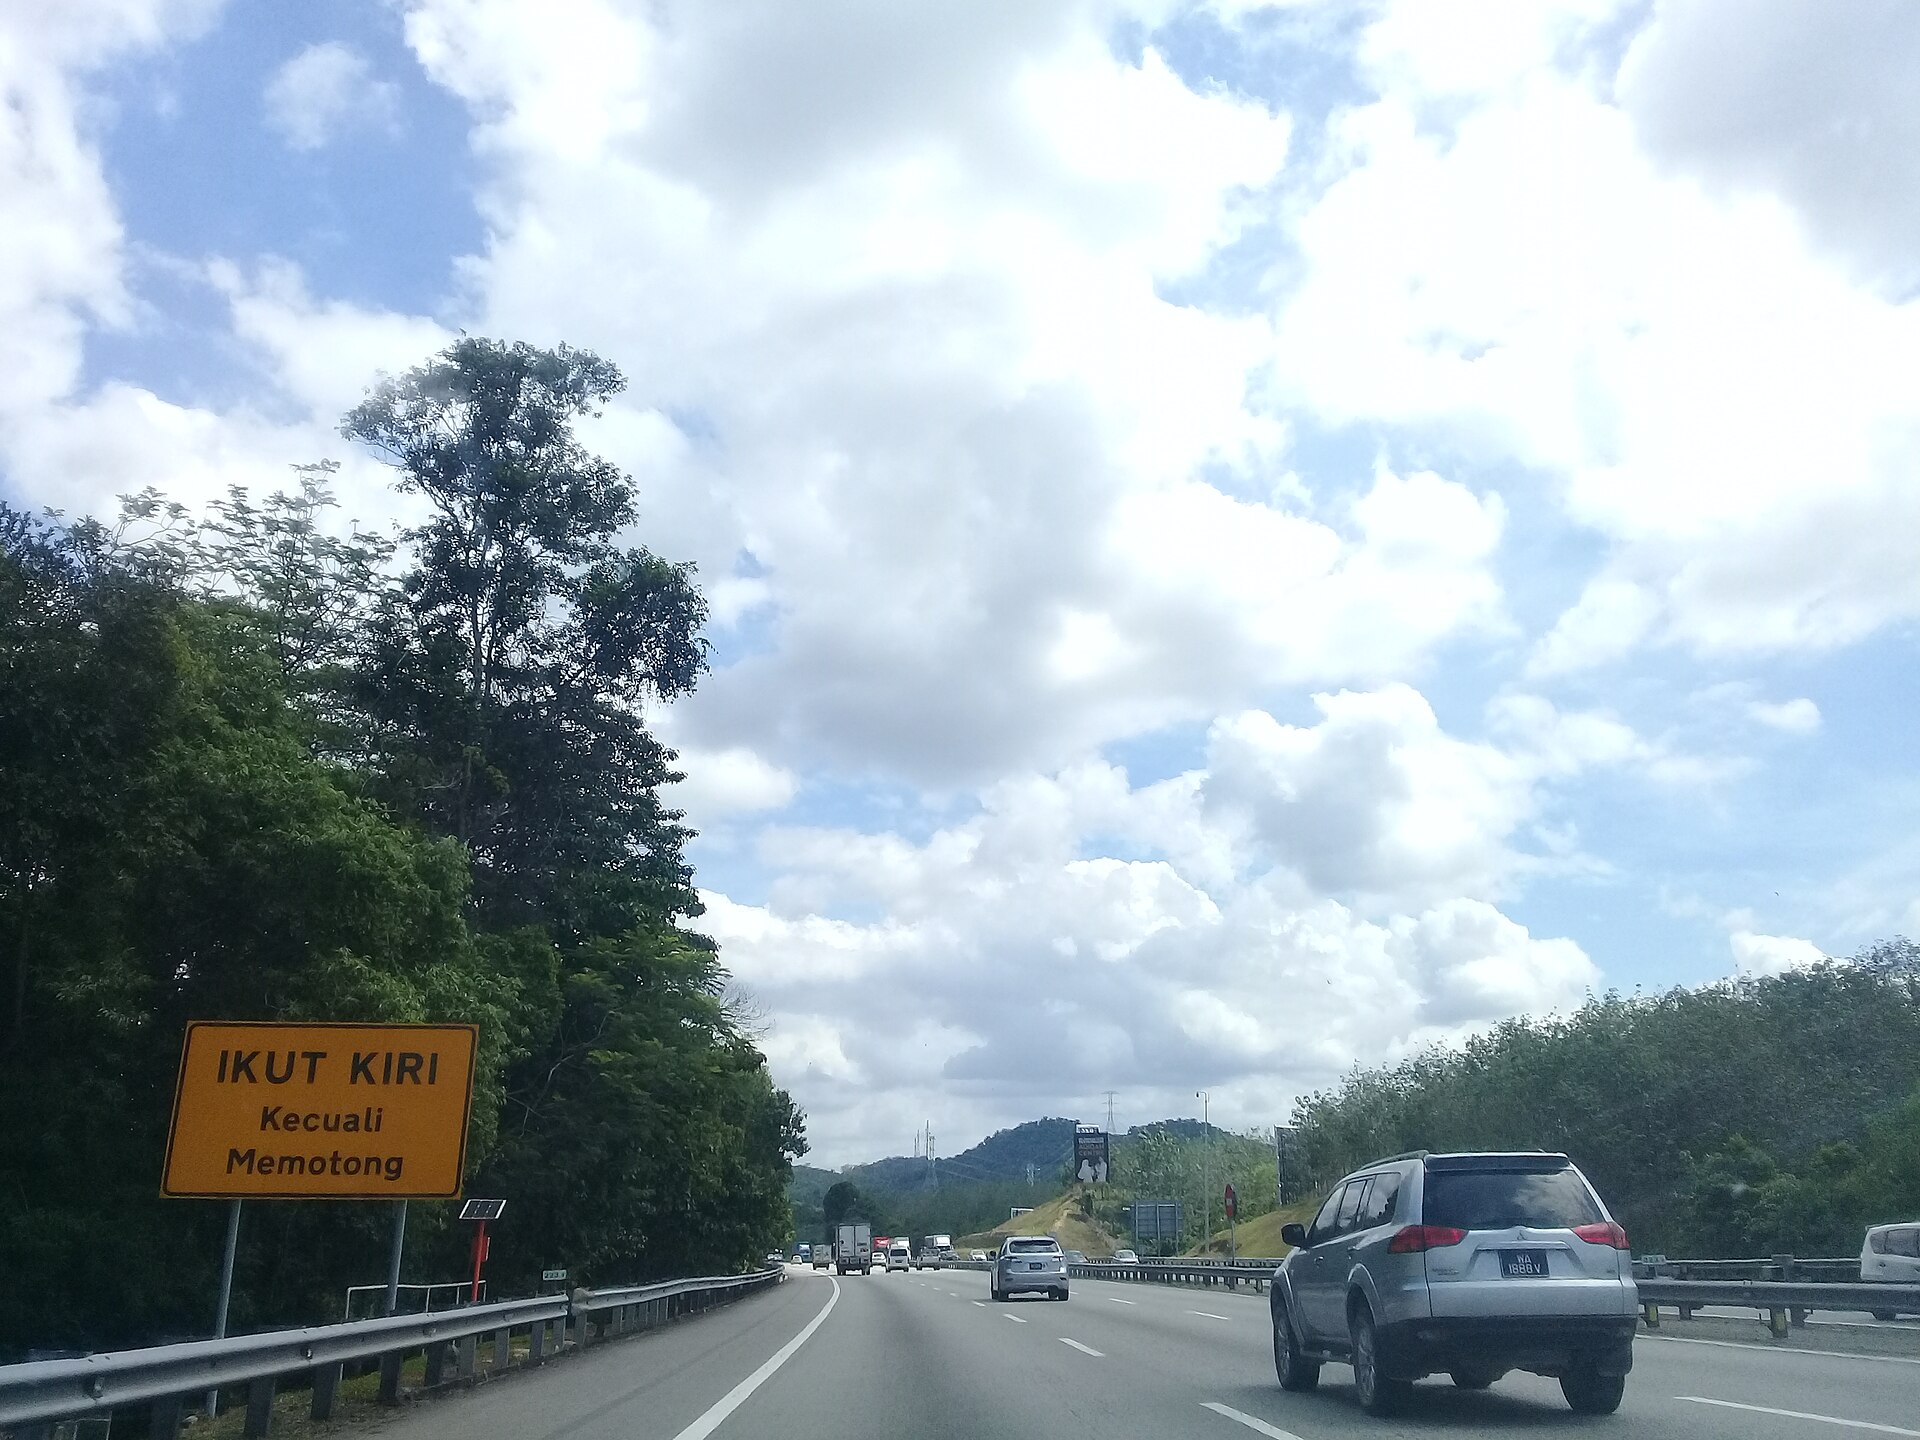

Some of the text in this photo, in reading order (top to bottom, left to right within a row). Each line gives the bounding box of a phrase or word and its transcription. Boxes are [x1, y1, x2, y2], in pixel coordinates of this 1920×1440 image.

[217, 1050, 439, 1085] IKUT KIRI
[260, 1106, 383, 1133] Kecuali
[226, 1148, 404, 1181] Memotong
[1516, 1254, 1532, 1264] WA
